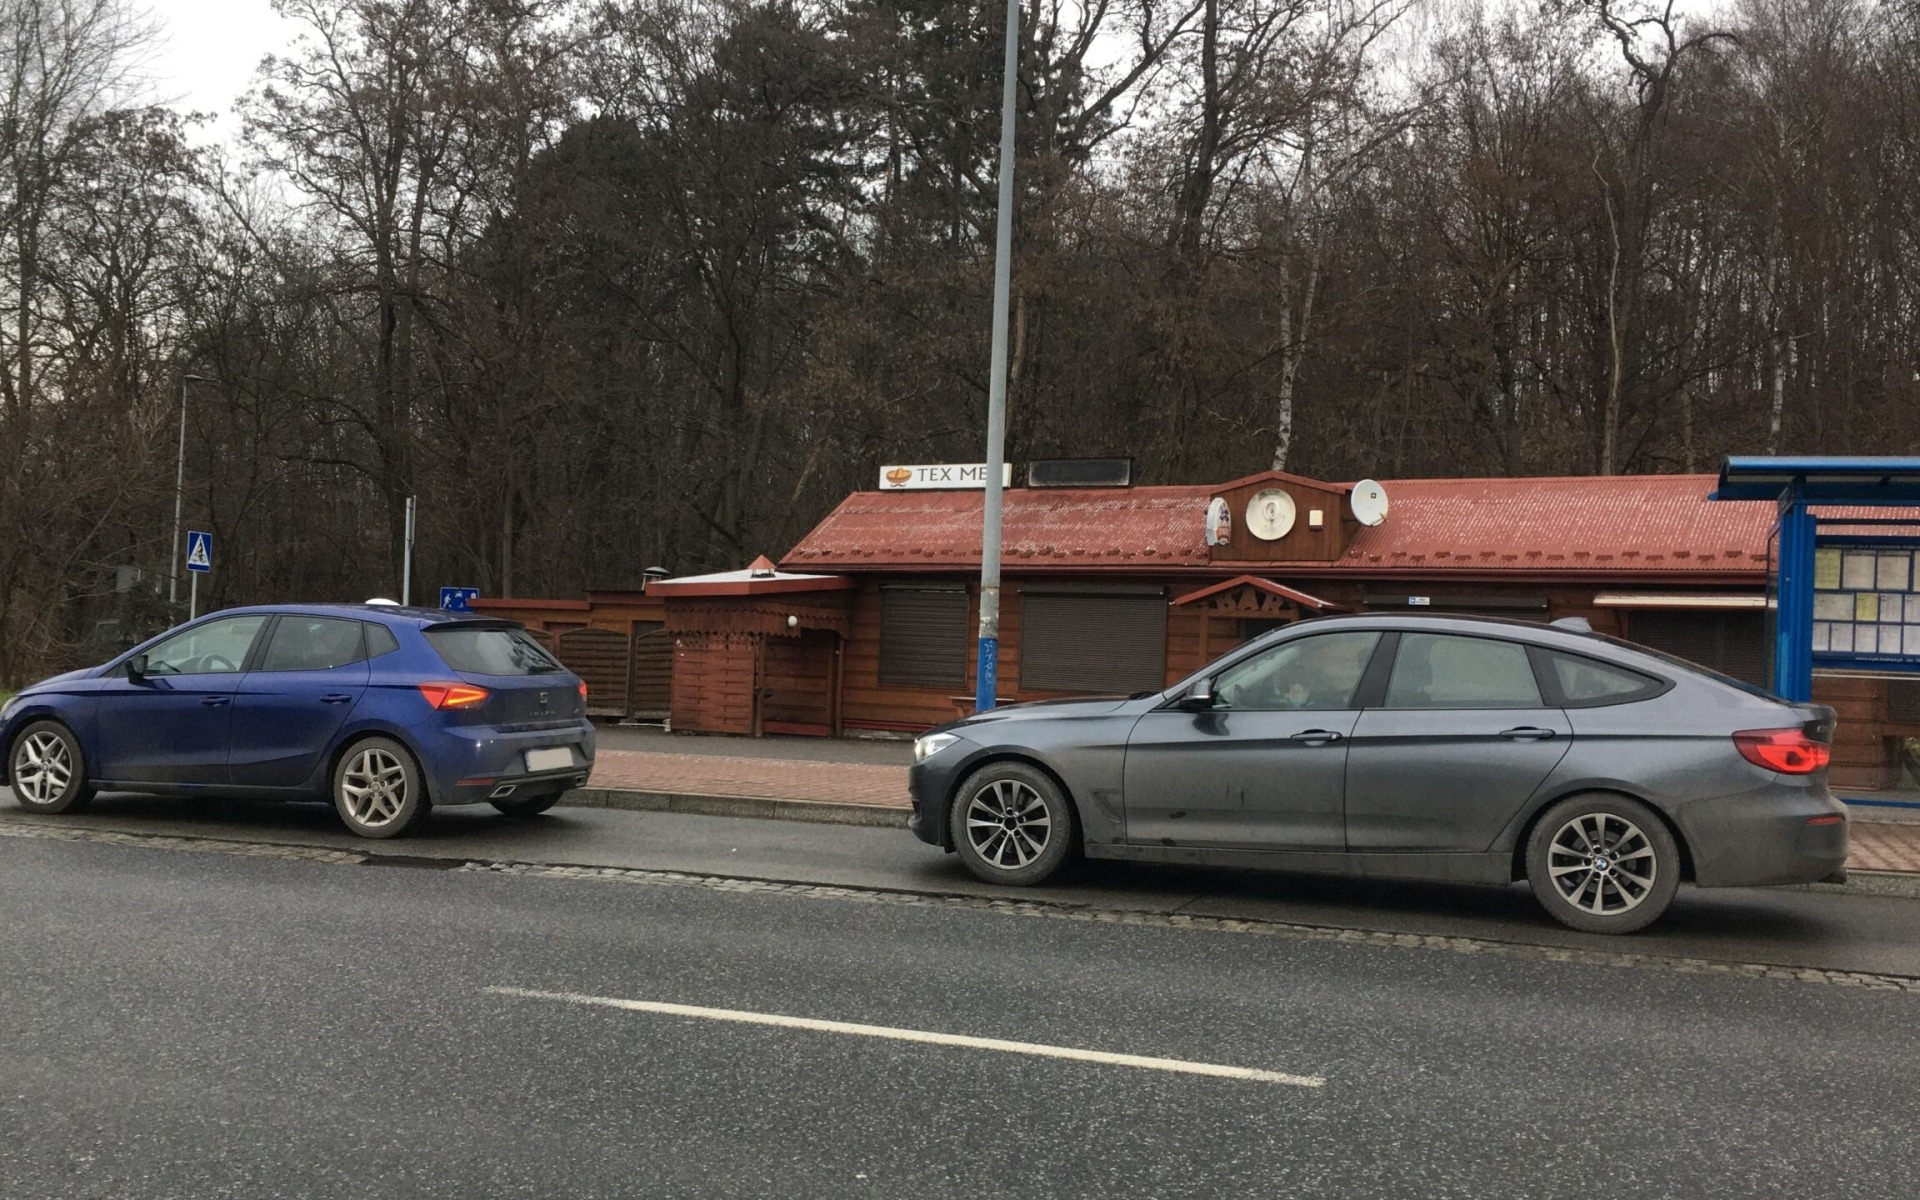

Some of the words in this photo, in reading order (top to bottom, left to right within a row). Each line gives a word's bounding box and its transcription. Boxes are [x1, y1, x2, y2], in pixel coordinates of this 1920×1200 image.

[917, 467, 952, 482] TEX
[959, 466, 987, 481] ME
[1216, 588, 1284, 612] BAR
